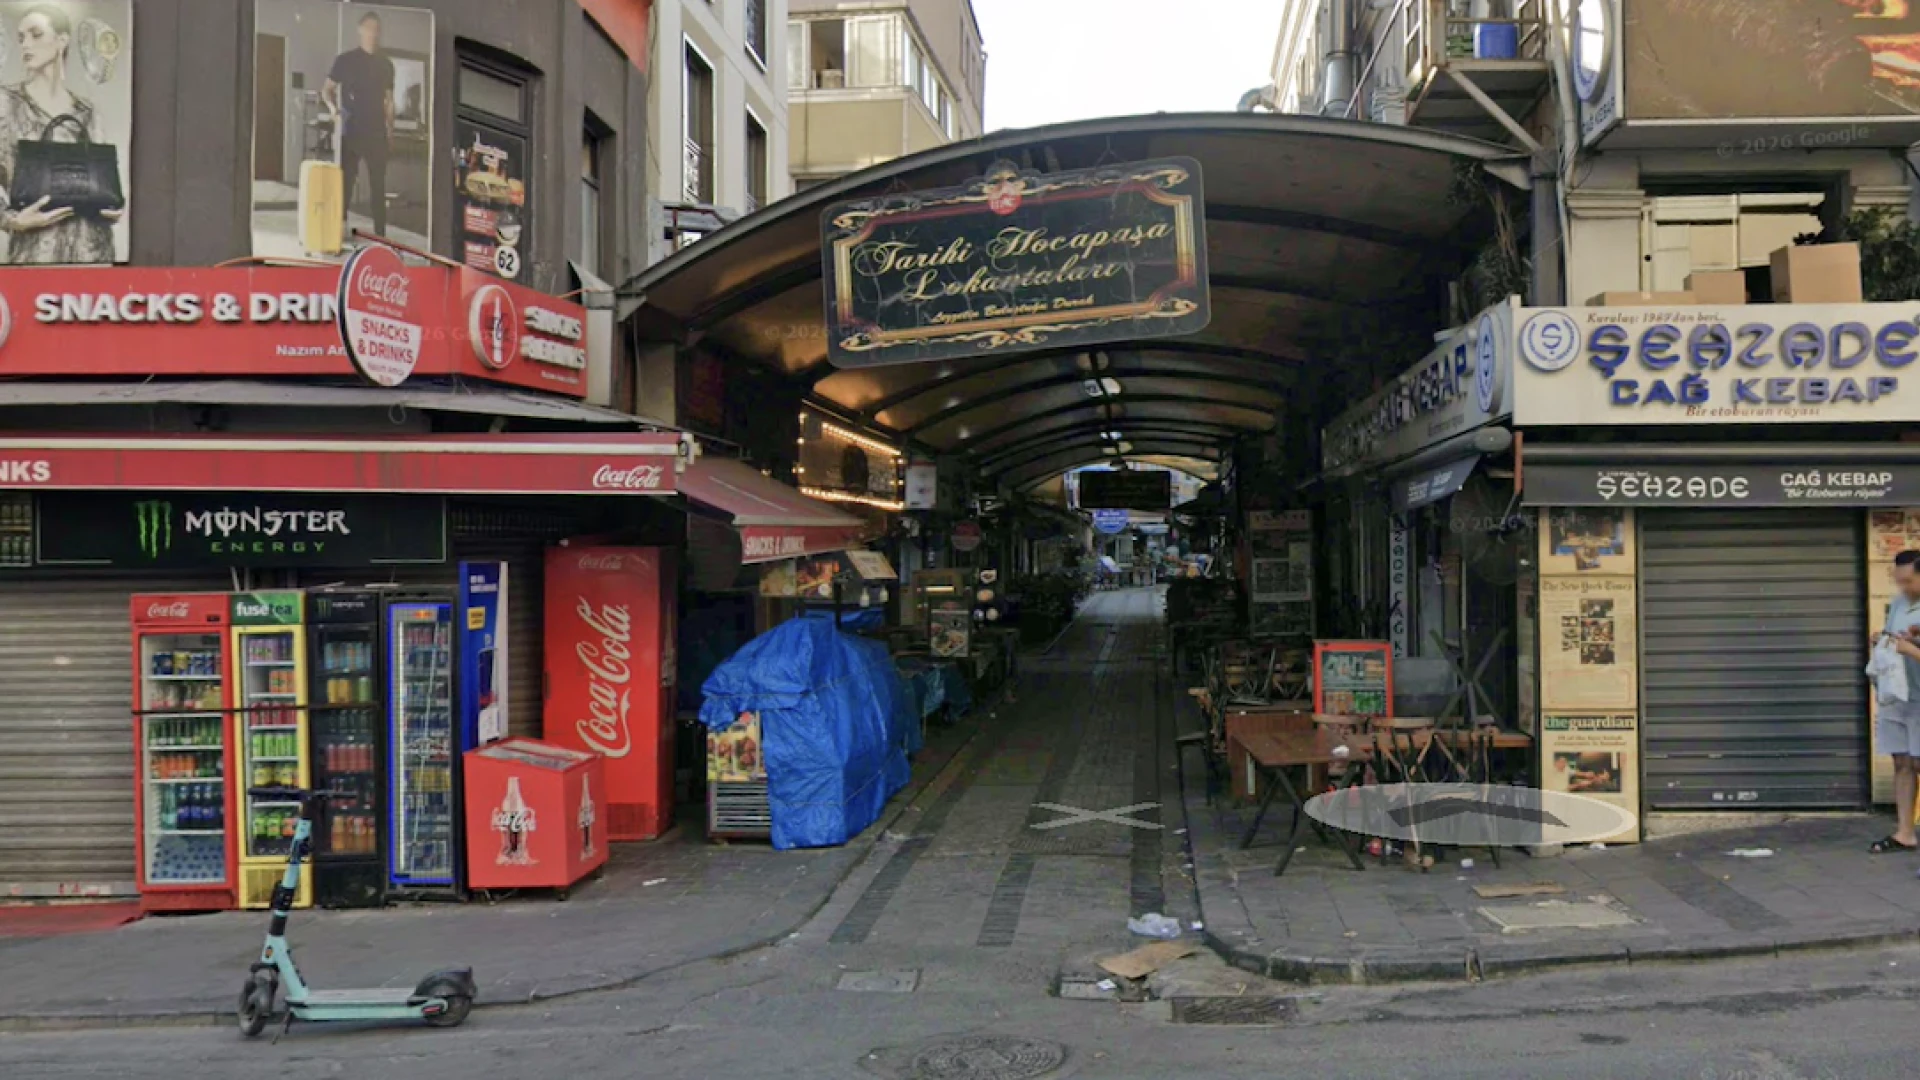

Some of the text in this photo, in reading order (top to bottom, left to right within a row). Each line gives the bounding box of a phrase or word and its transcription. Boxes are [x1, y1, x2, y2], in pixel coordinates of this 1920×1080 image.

[498, 250, 514, 272] 62
[850, 237, 972, 276] Tarihi
[35, 293, 203, 321] SNACKS
[212, 293, 241, 321] &
[250, 293, 337, 321] DRIN
[362, 319, 410, 344] SNACKS
[369, 341, 413, 363] DRINKS
[1734, 377, 1898, 405] KEBAP
[1686, 404, 1706, 417] Bir
[0, 460, 51, 482] KS
[1827, 472, 1893, 486] KEBAP
[211, 541, 325, 553] ENERGY
[1542, 581, 1558, 592] The
[1581, 581, 1602, 593] York
